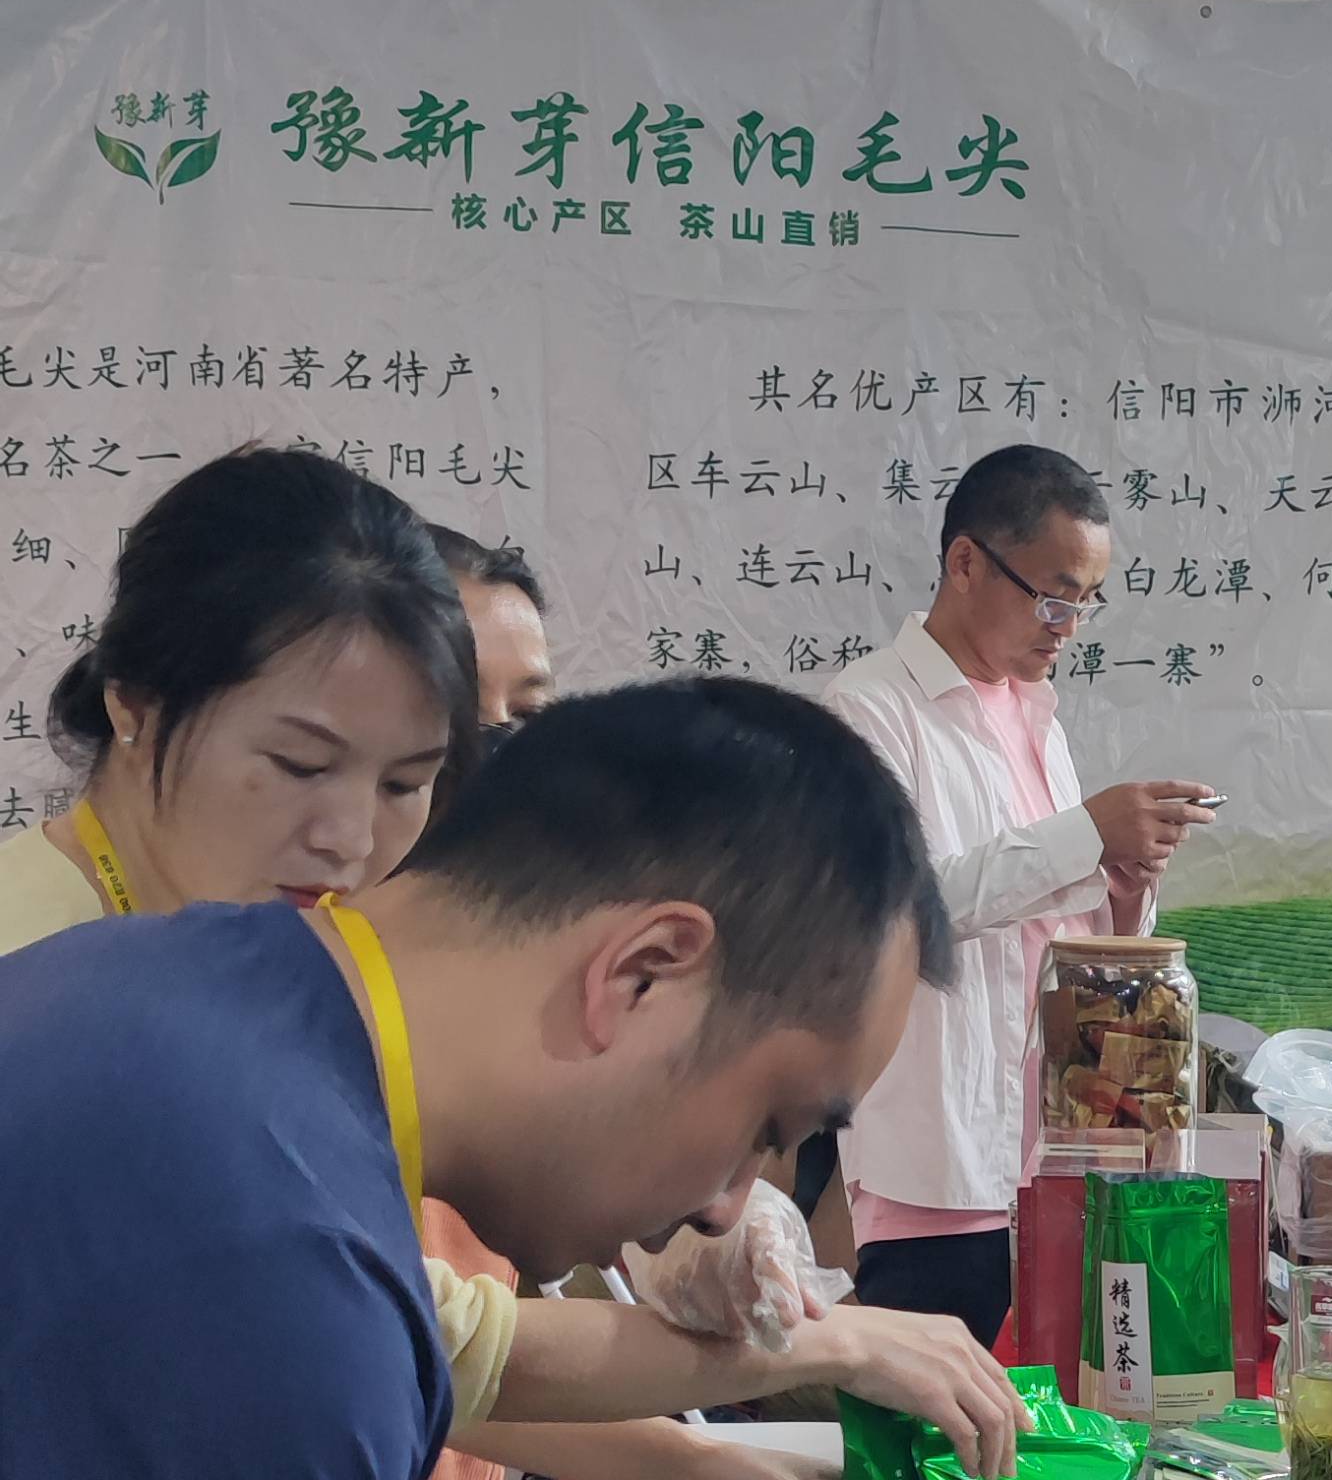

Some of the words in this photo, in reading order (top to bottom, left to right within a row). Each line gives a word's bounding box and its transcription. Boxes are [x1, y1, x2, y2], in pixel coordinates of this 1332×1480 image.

[111, 88, 211, 131] 豫新芽
[271, 84, 1030, 201] 豫新芽信阳毛尖
[451, 193, 631, 236] 核心产区
[679, 202, 860, 247] 茶山直销
[291, 435, 531, 491] 信阳毛尖
[1108, 1278, 1139, 1373] 精选茶
